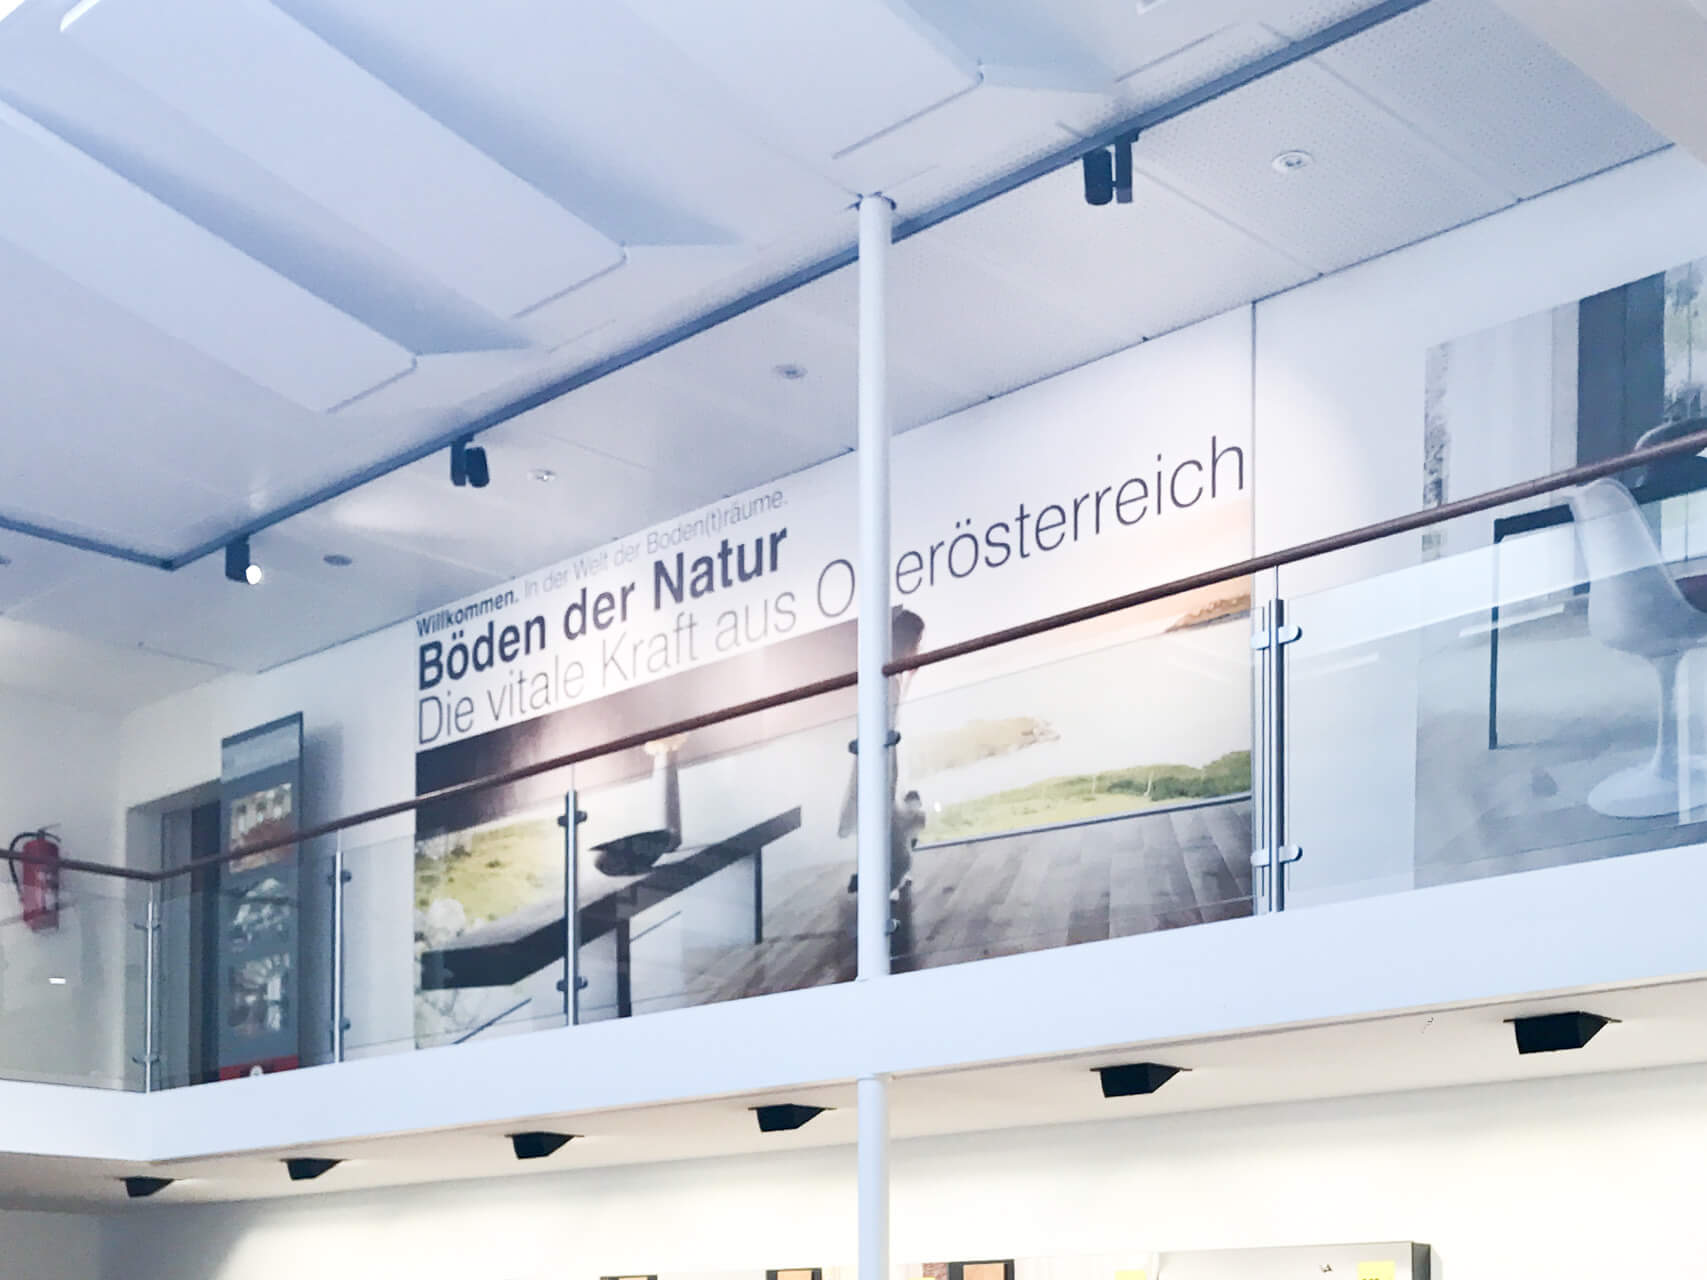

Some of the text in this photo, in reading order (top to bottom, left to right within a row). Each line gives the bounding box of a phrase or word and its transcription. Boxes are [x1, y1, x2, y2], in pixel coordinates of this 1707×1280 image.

[416, 590, 520, 637] Willkommen.
[614, 540, 641, 567] der
[418, 435, 1244, 745] Die vitale Kraft aus Oerösterreich
[418, 528, 788, 691] Böden der Natur
